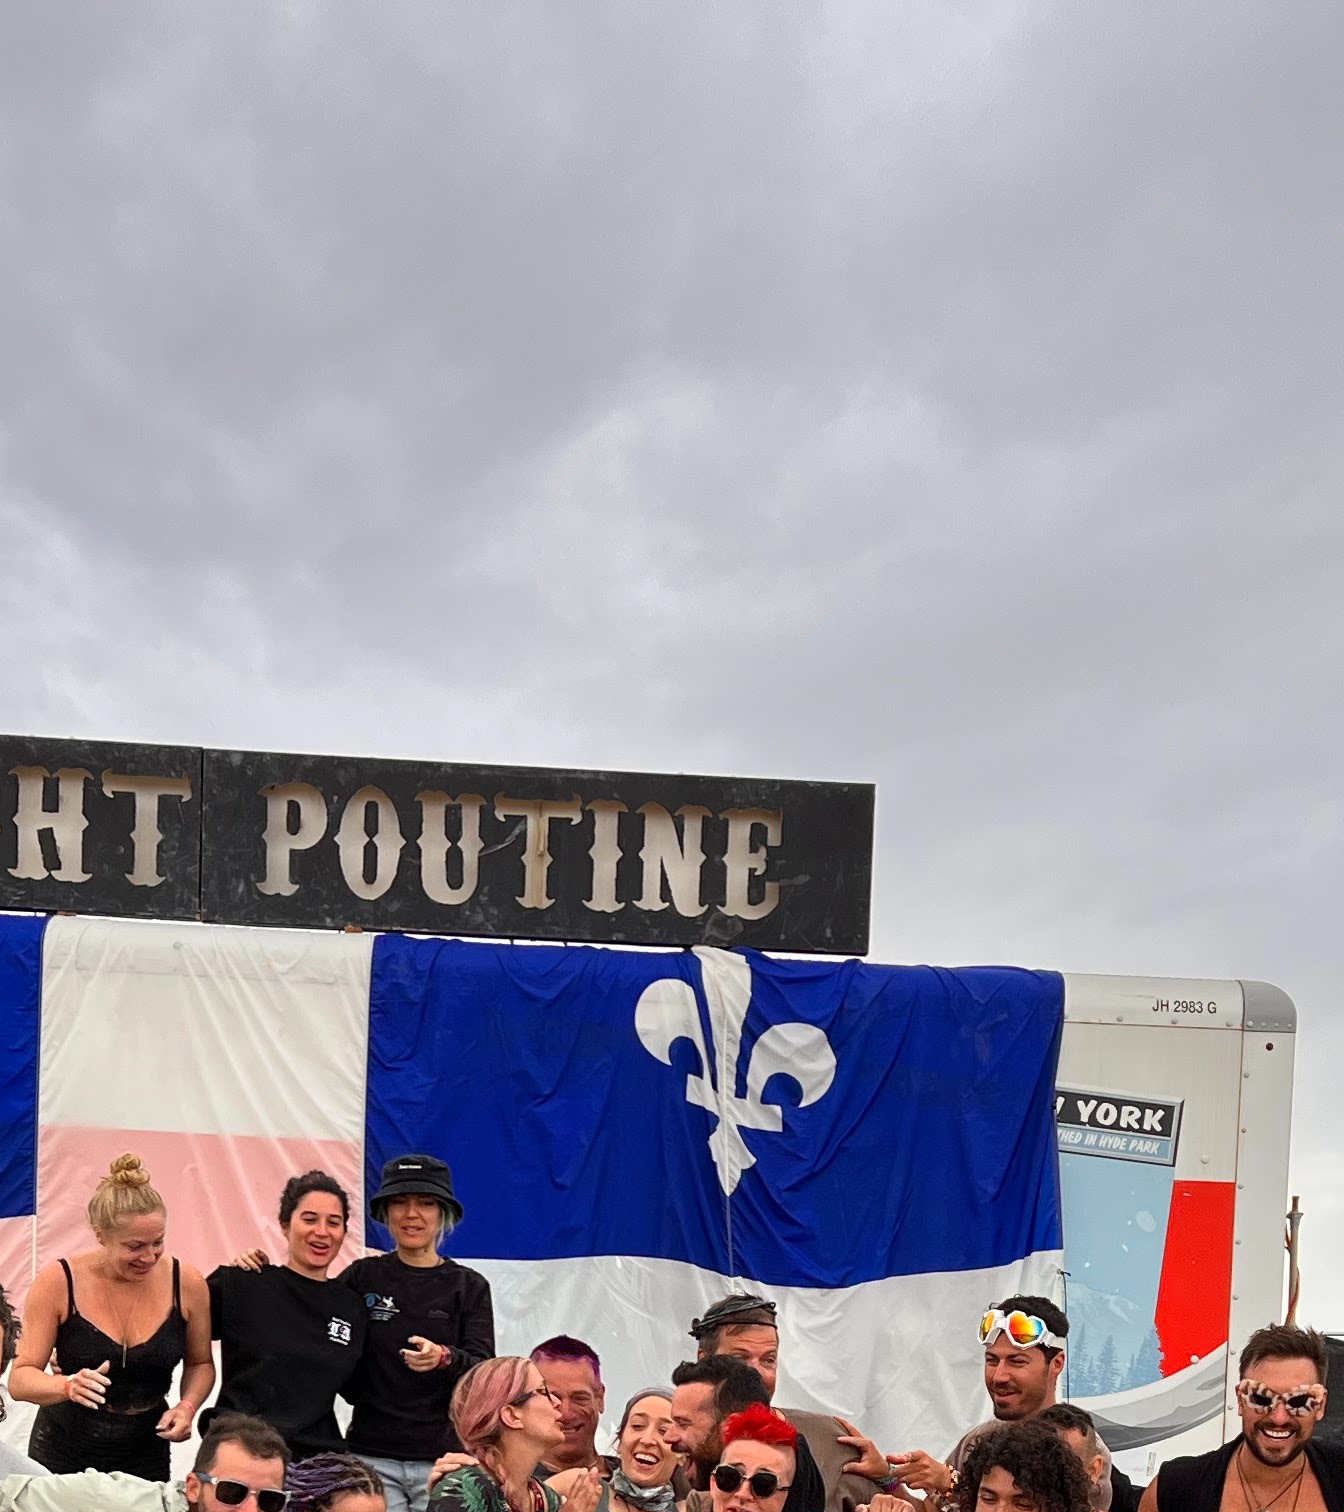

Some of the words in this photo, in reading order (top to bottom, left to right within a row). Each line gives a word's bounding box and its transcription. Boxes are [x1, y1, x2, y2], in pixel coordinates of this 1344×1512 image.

[255, 780, 785, 921] POUTINE
[1152, 999, 1169, 1013] JH
[1173, 1000, 1204, 1014] 2983
[1207, 1001, 1217, 1014] G
[1076, 1099, 1165, 1132] YORK
[1083, 1132, 1098, 1146] IN
[1098, 1134, 1128, 1151] HYDE
[1128, 1139, 1161, 1155] PARK
